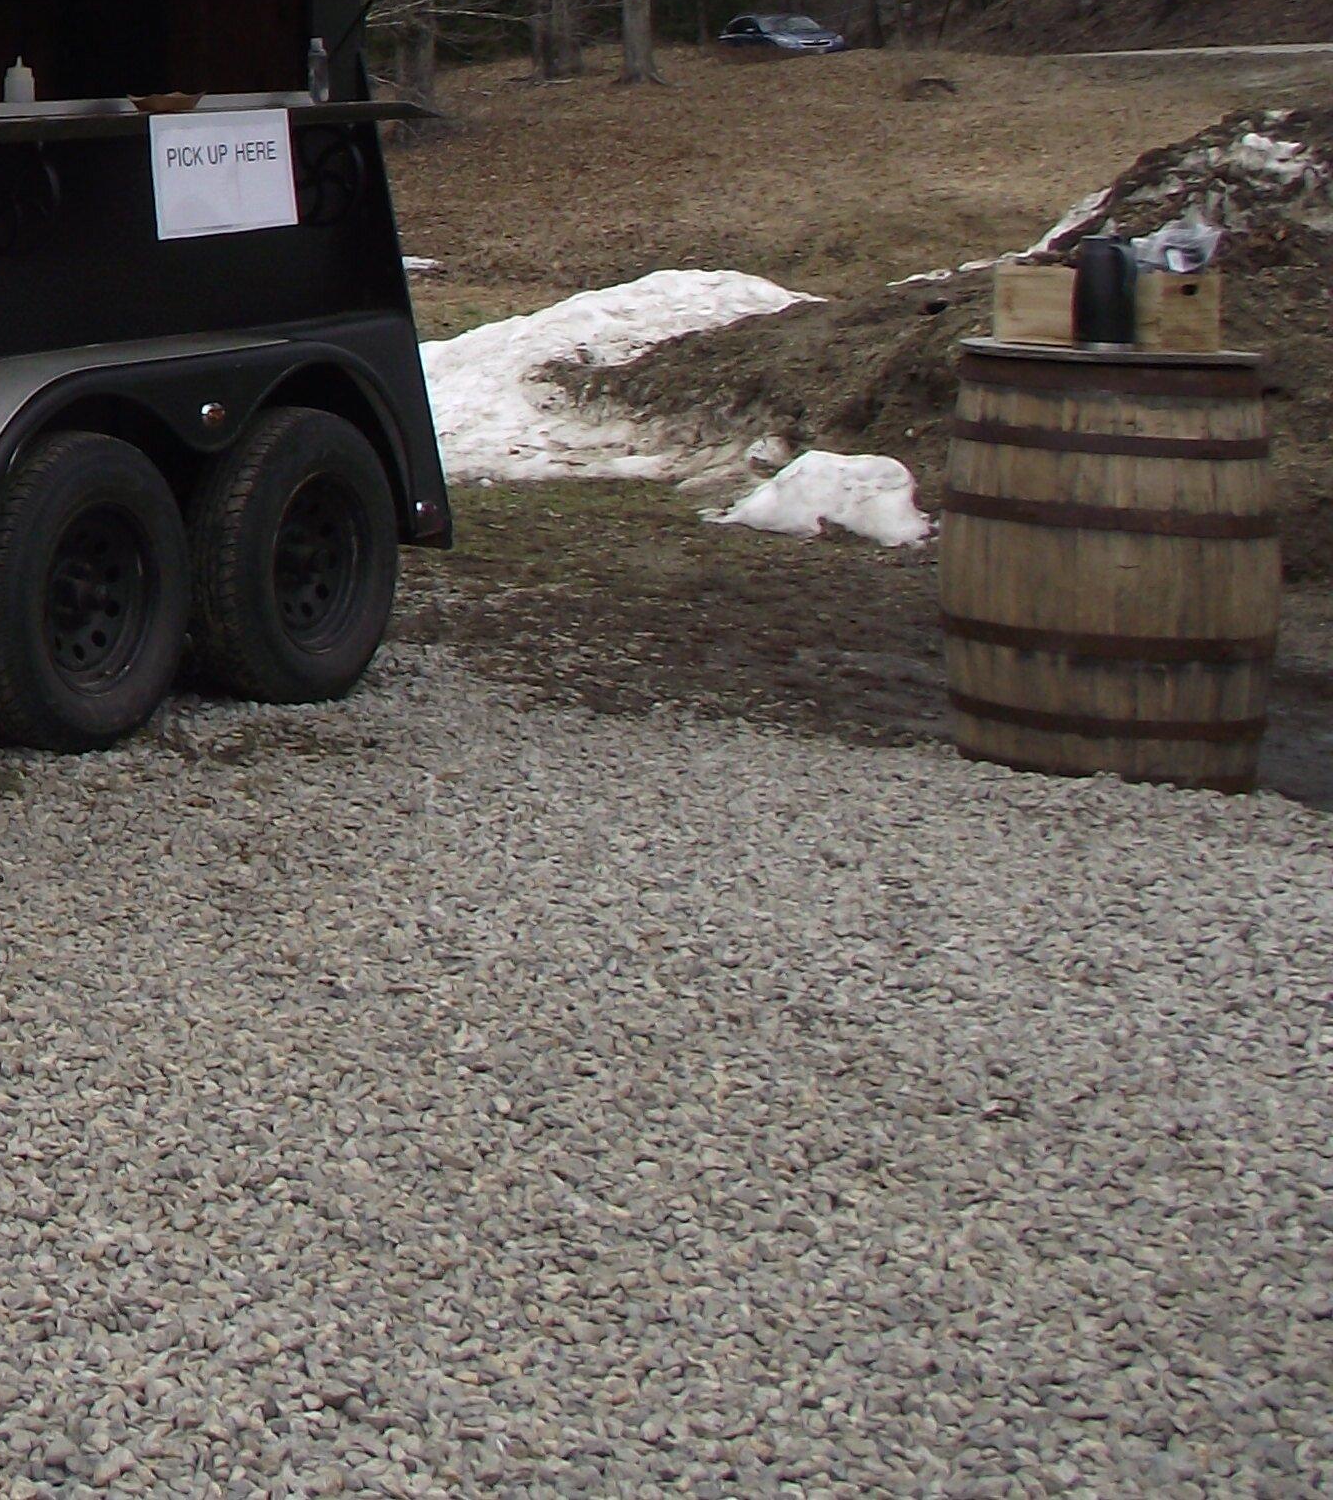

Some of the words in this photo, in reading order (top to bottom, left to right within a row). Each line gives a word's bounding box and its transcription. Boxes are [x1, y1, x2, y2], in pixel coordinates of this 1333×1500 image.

[166, 144, 204, 168] PICK
[207, 143, 228, 165] UP
[235, 140, 277, 162] HERE
